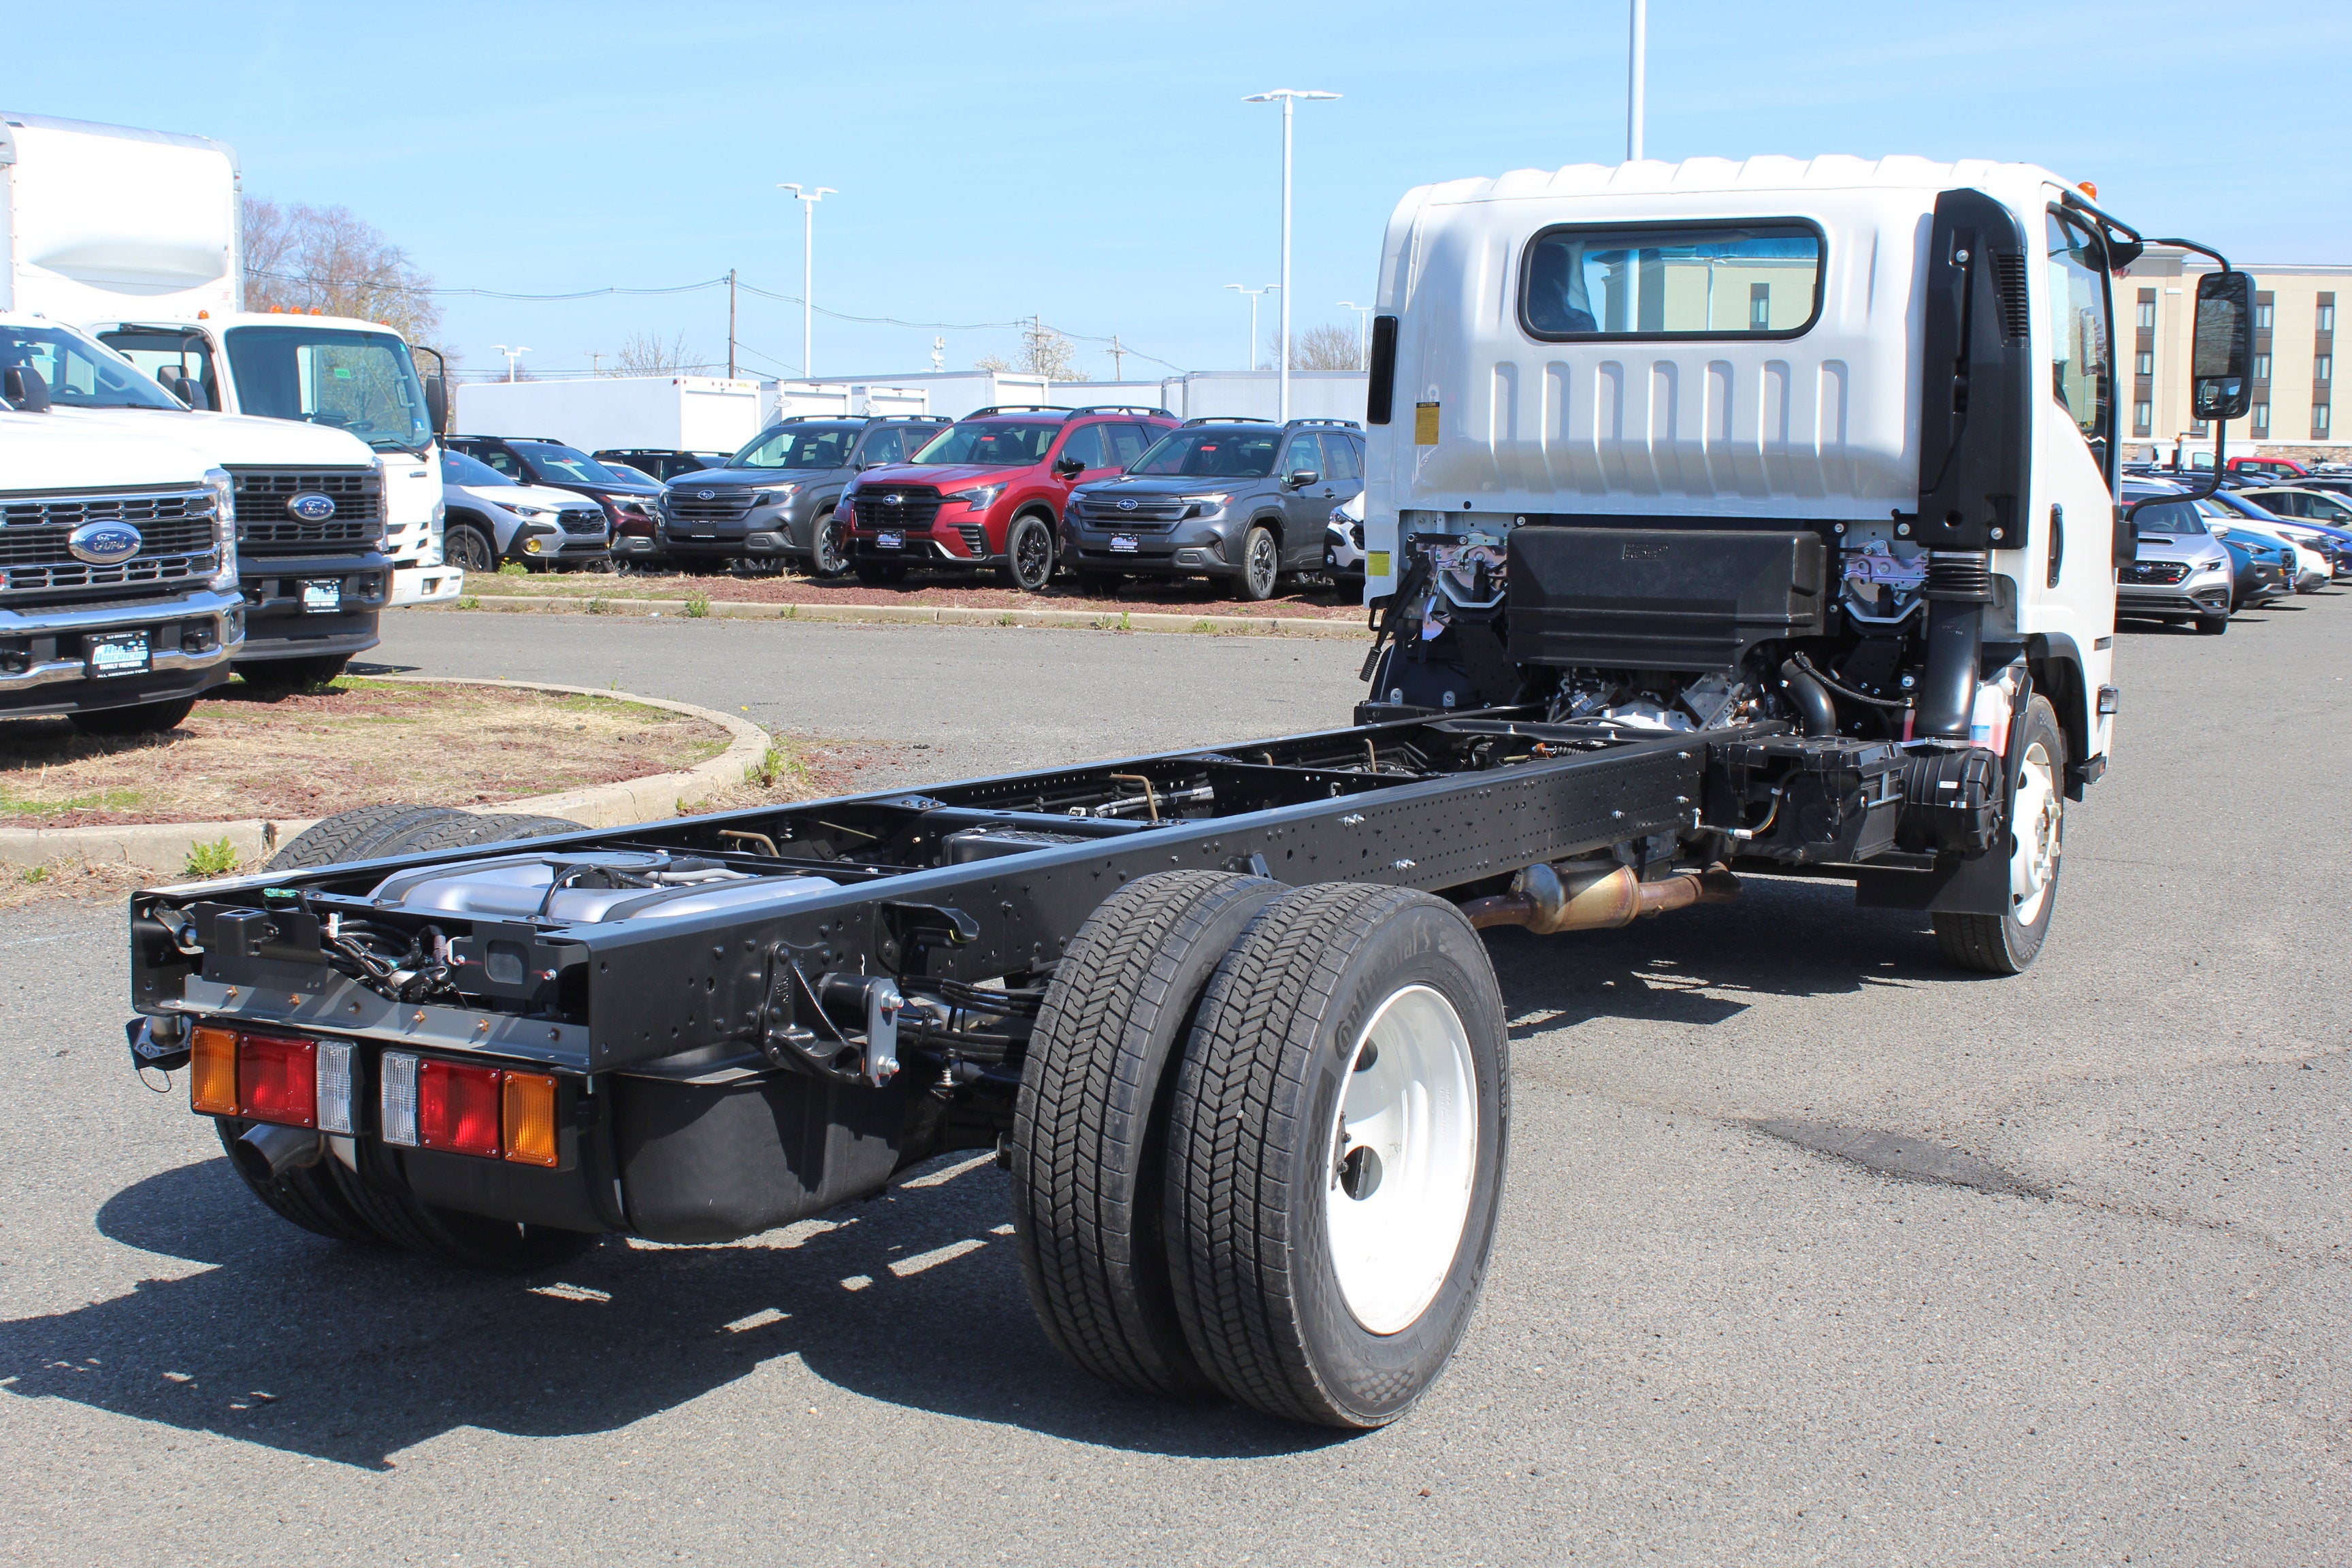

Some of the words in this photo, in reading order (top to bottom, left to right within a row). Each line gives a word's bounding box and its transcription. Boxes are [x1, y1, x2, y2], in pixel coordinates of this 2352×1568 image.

[93, 533, 127, 551] Ford
[94, 651, 148, 663] AMERICAN
[118, 660, 143, 668] MEMBER
[1335, 915, 1420, 1060] Continental
